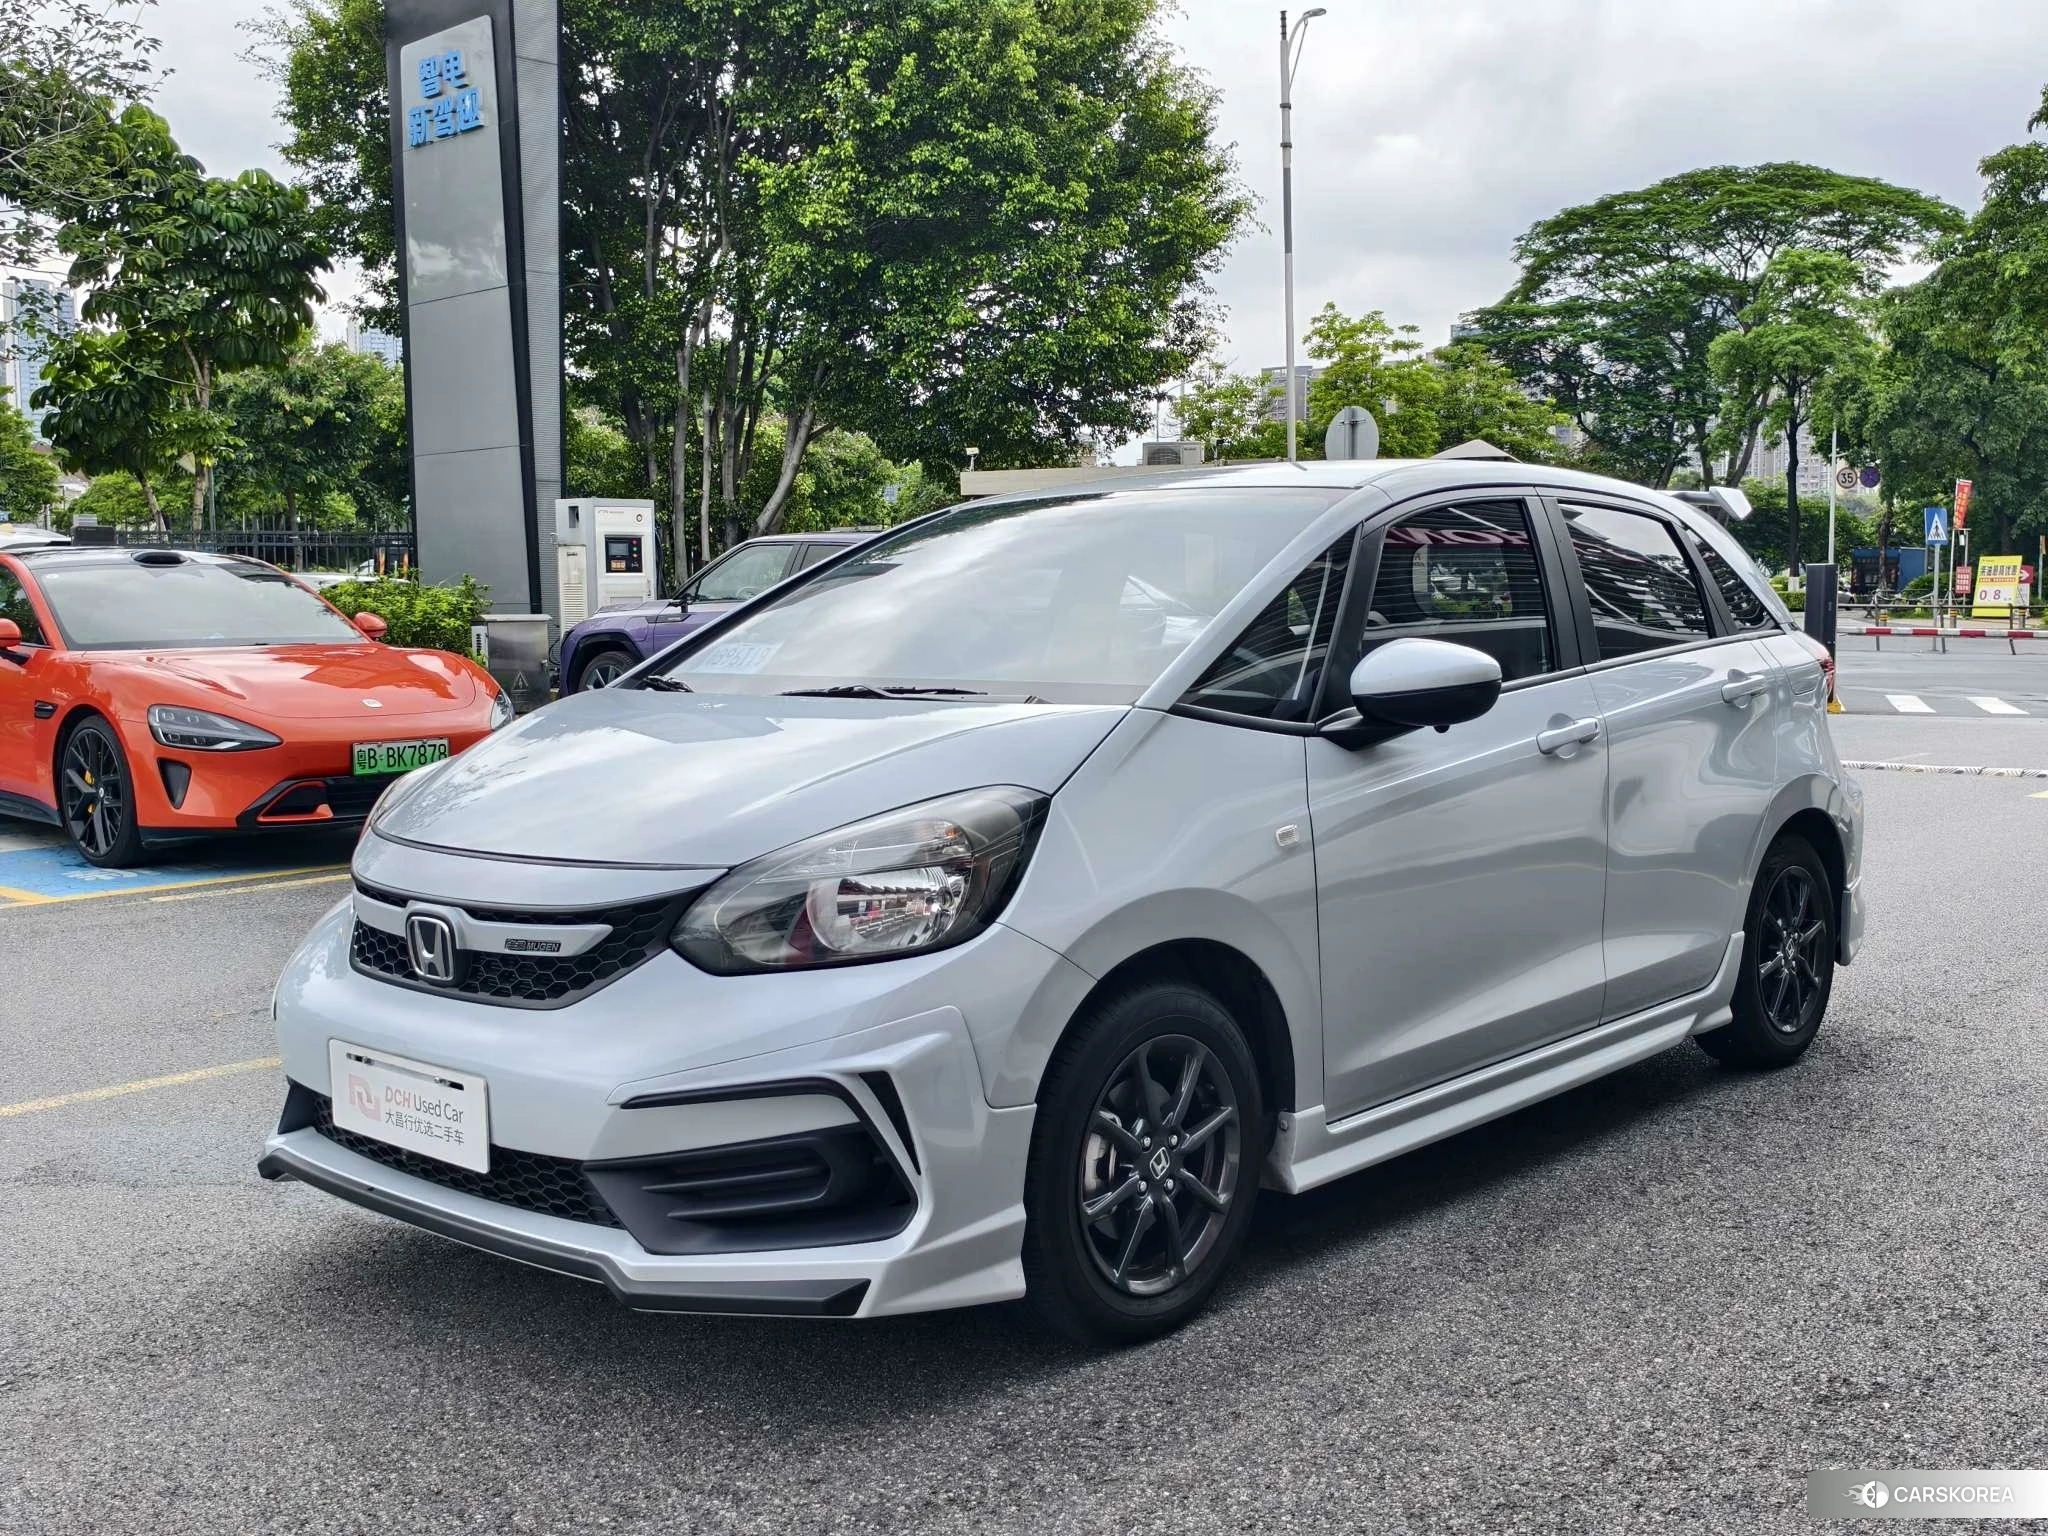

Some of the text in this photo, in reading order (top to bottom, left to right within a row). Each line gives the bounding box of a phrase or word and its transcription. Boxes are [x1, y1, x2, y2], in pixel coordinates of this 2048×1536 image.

[1841, 472, 1853, 484] 35
[527, 942, 559, 952] MUGEN
[385, 1086, 464, 1123] DCH Used Car
[385, 1111, 464, 1145] 大昌行优选二手车
